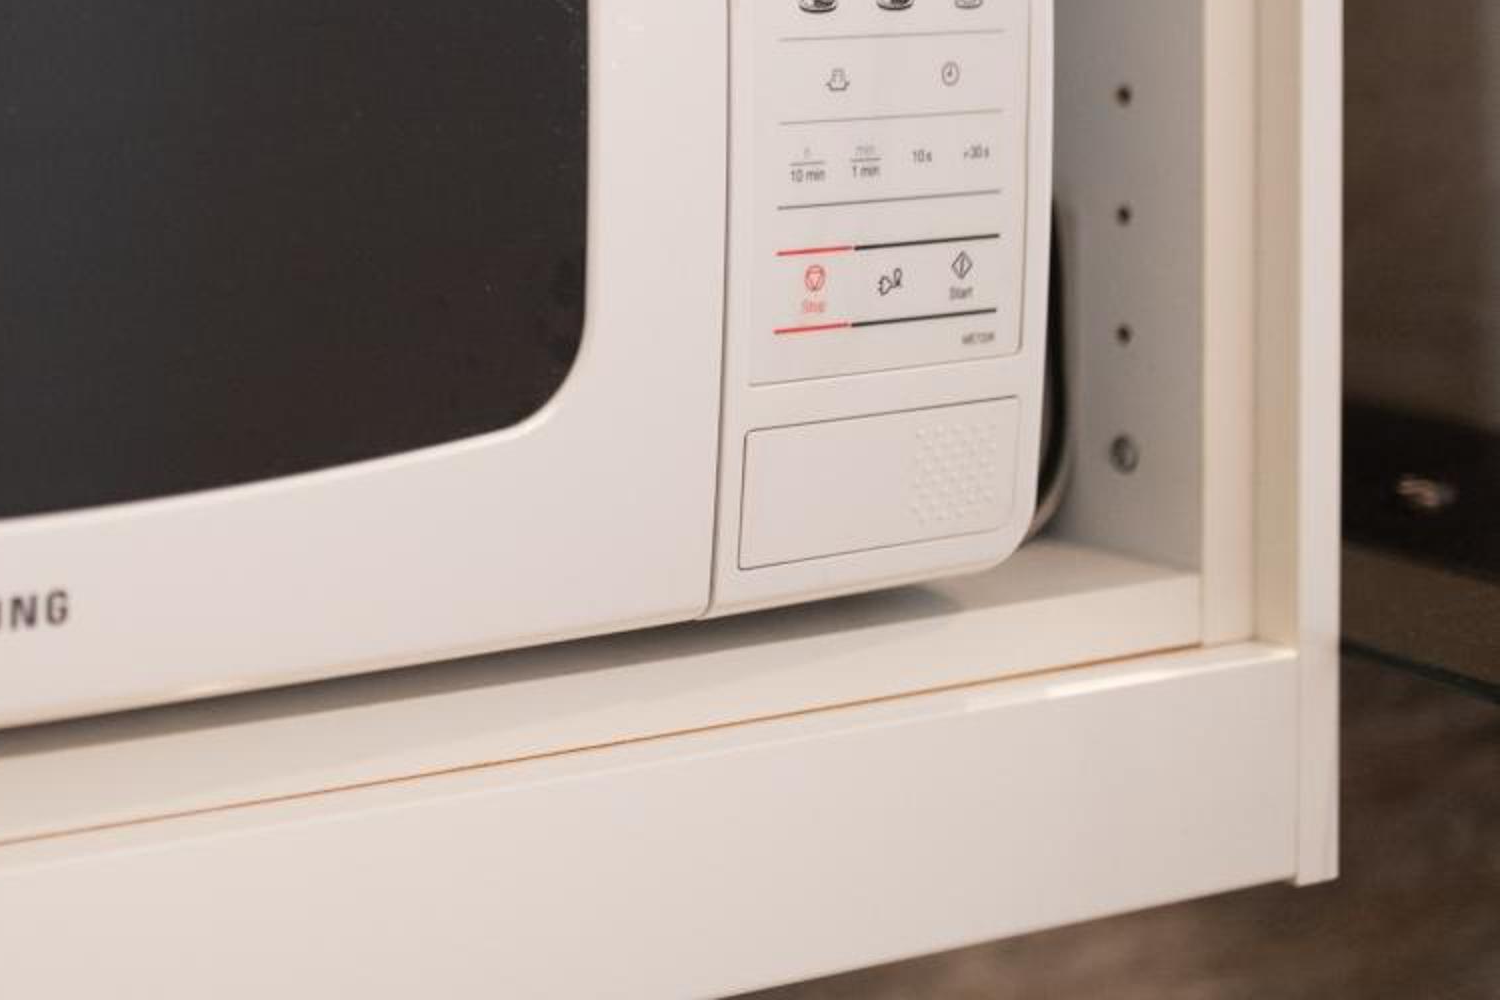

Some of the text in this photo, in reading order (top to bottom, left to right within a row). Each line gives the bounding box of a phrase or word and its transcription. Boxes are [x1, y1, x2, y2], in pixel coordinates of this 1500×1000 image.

[790, 168, 826, 183] 10 min
[859, 164, 880, 177] min
[949, 285, 974, 300] Start
